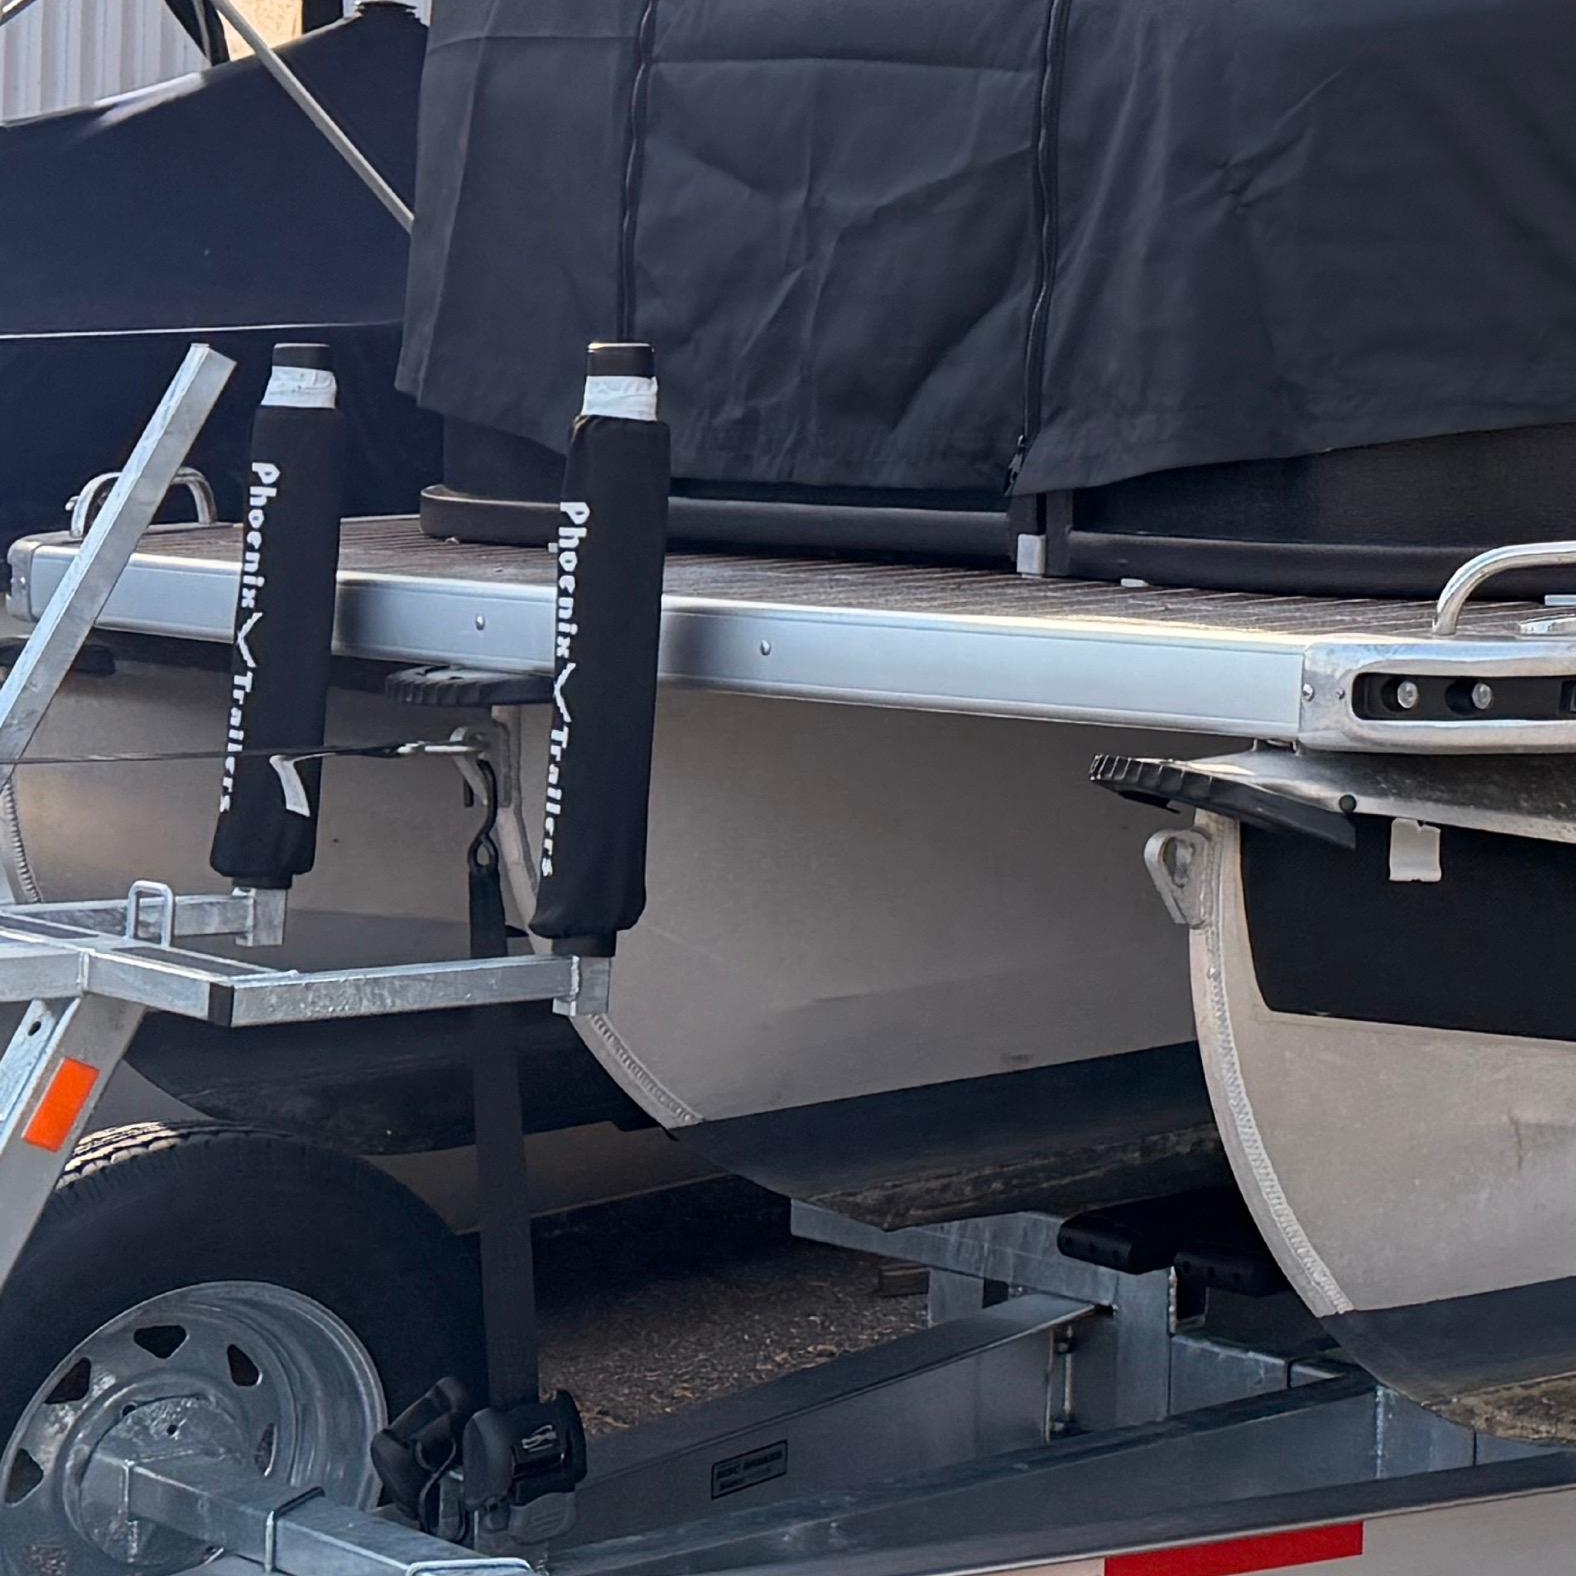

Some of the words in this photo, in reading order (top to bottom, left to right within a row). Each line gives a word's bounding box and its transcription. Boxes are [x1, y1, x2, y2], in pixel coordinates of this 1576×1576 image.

[241, 461, 281, 609] Phoenix
[556, 501, 591, 659] Phoenix
[219, 671, 254, 814] Trailers
[541, 725, 569, 878] Trailers
